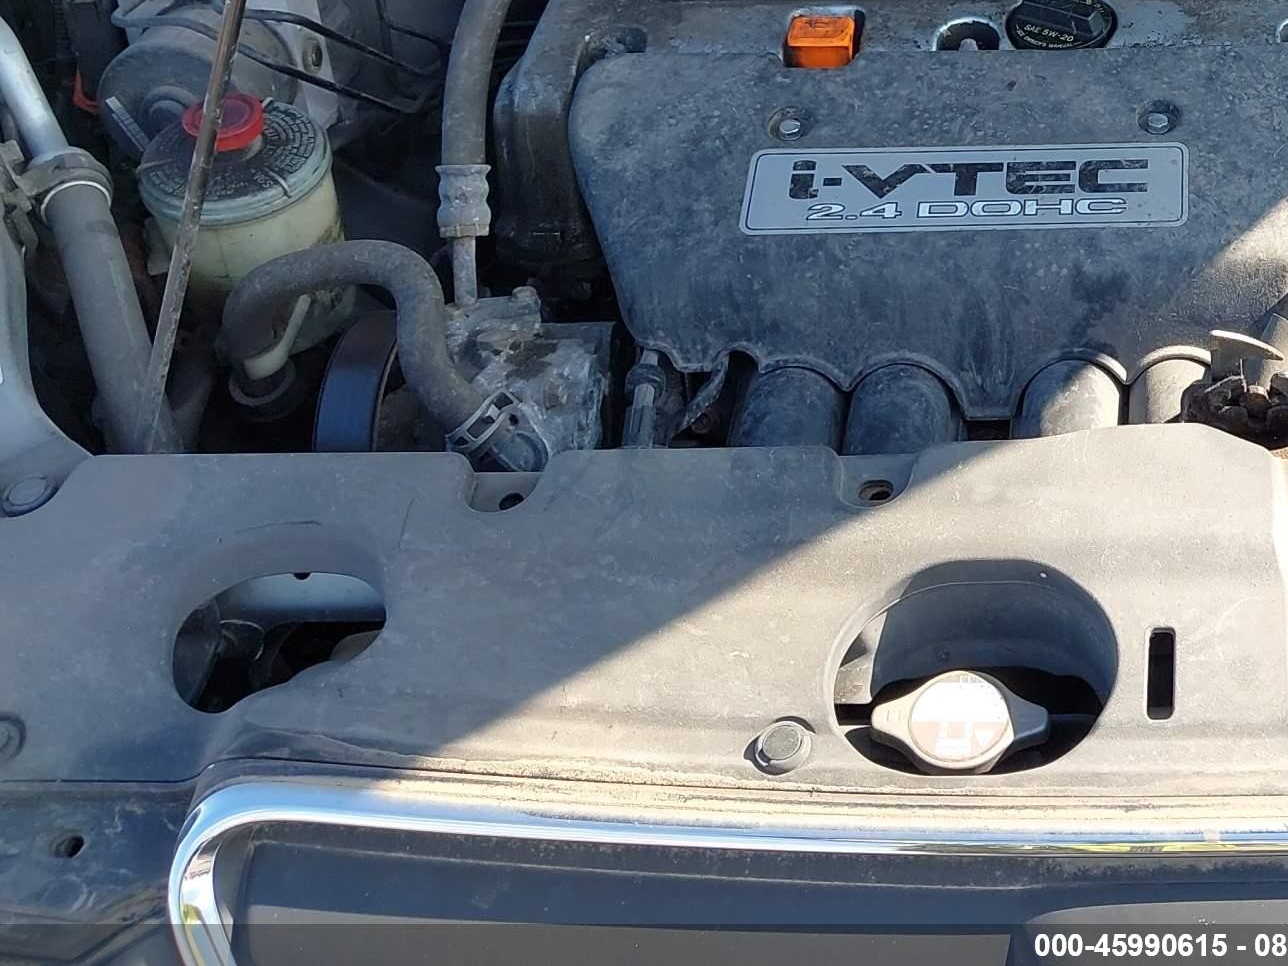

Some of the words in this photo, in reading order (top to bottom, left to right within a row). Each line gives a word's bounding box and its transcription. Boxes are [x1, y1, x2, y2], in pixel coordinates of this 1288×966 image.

[1023, 24, 1042, 34] SAE
[1042, 28, 1074, 42] 5W-20
[789, 159, 1149, 201] i-VTEC
[806, 198, 902, 220] 2.4
[916, 197, 1127, 219] DOHC
